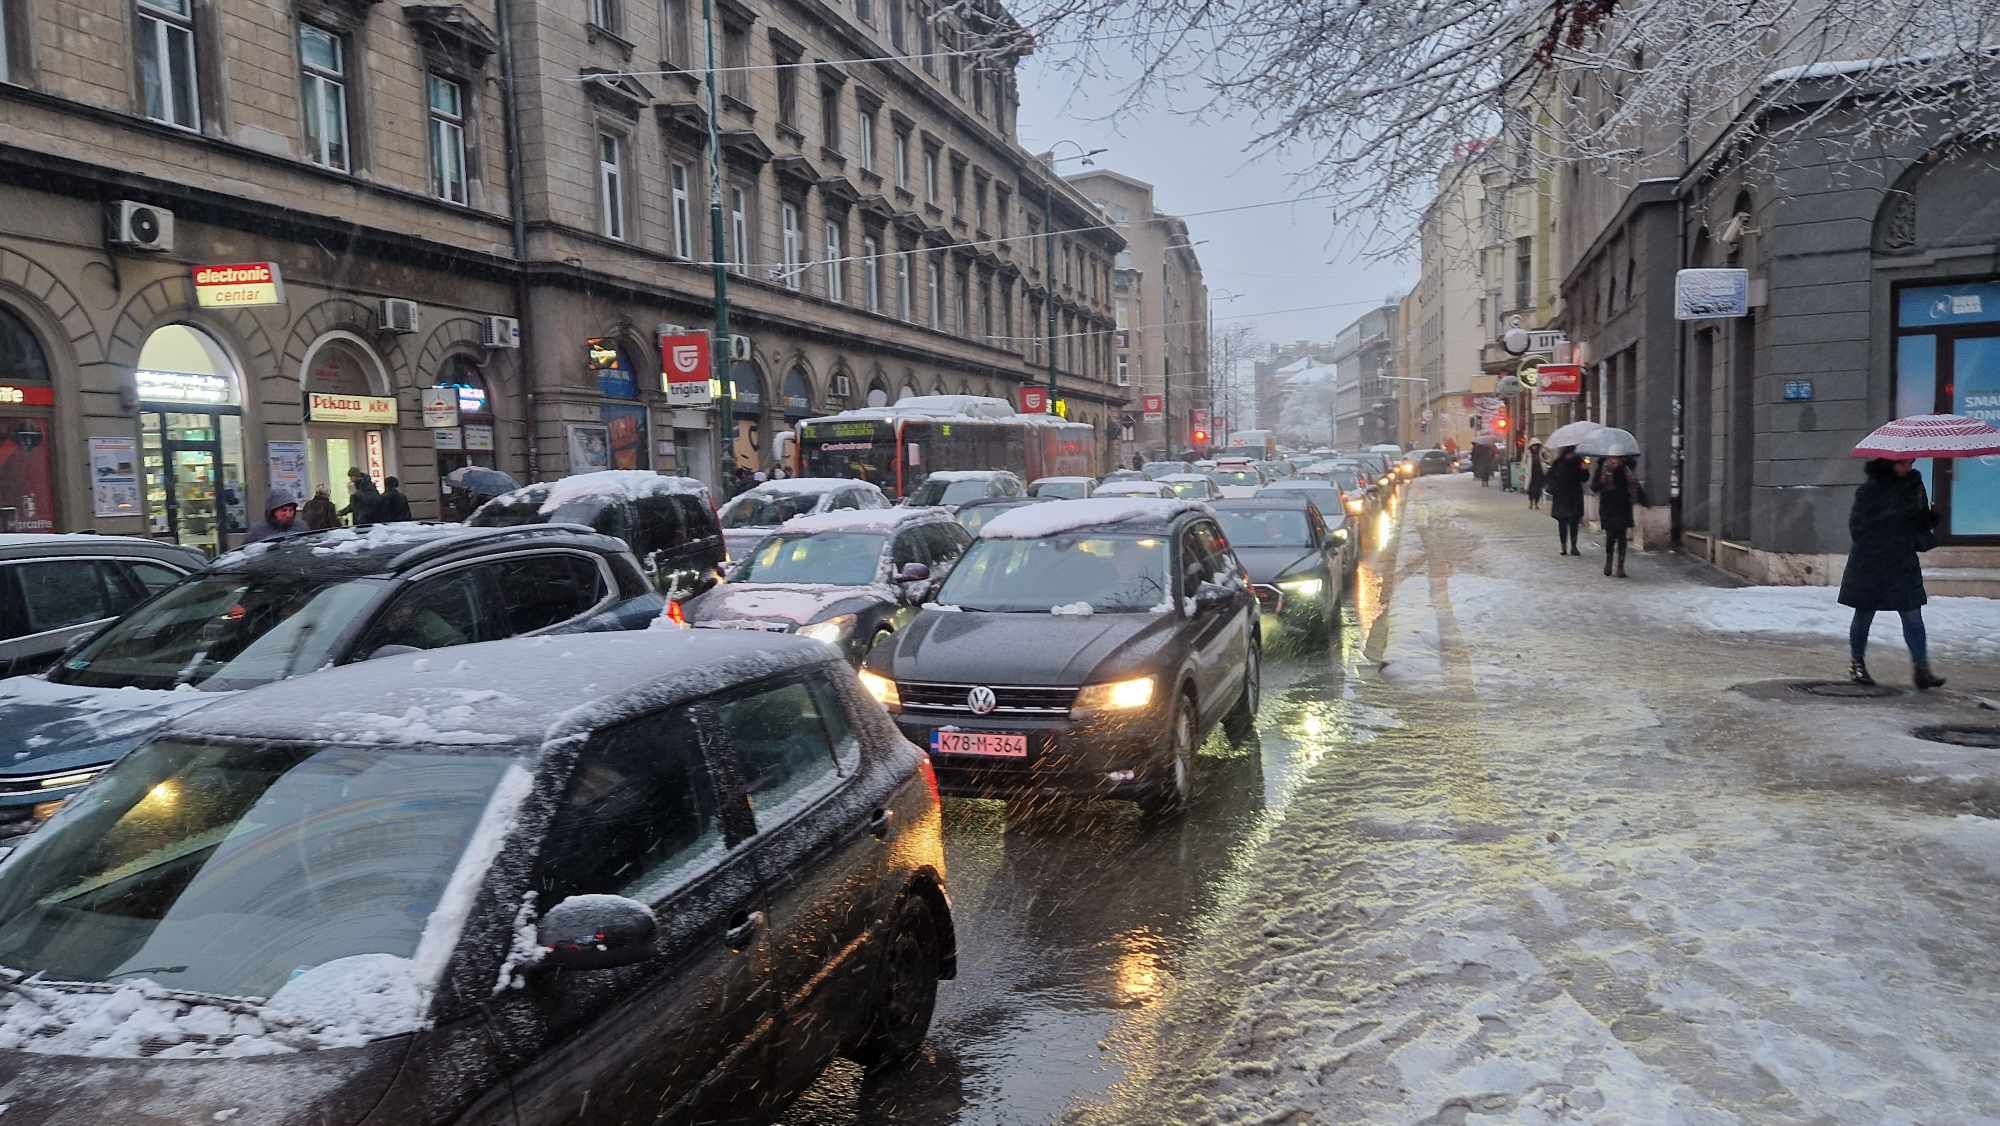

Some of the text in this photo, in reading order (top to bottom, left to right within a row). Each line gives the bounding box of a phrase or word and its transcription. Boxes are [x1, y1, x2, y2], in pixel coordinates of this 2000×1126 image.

[197, 265, 270, 284] electronic
[215, 289, 260, 302] centar
[671, 384, 706, 398] triglav
[312, 394, 362, 411] Pekara
[1964, 395, 2000, 408] SMA
[941, 734, 1023, 754] K78-M-364
